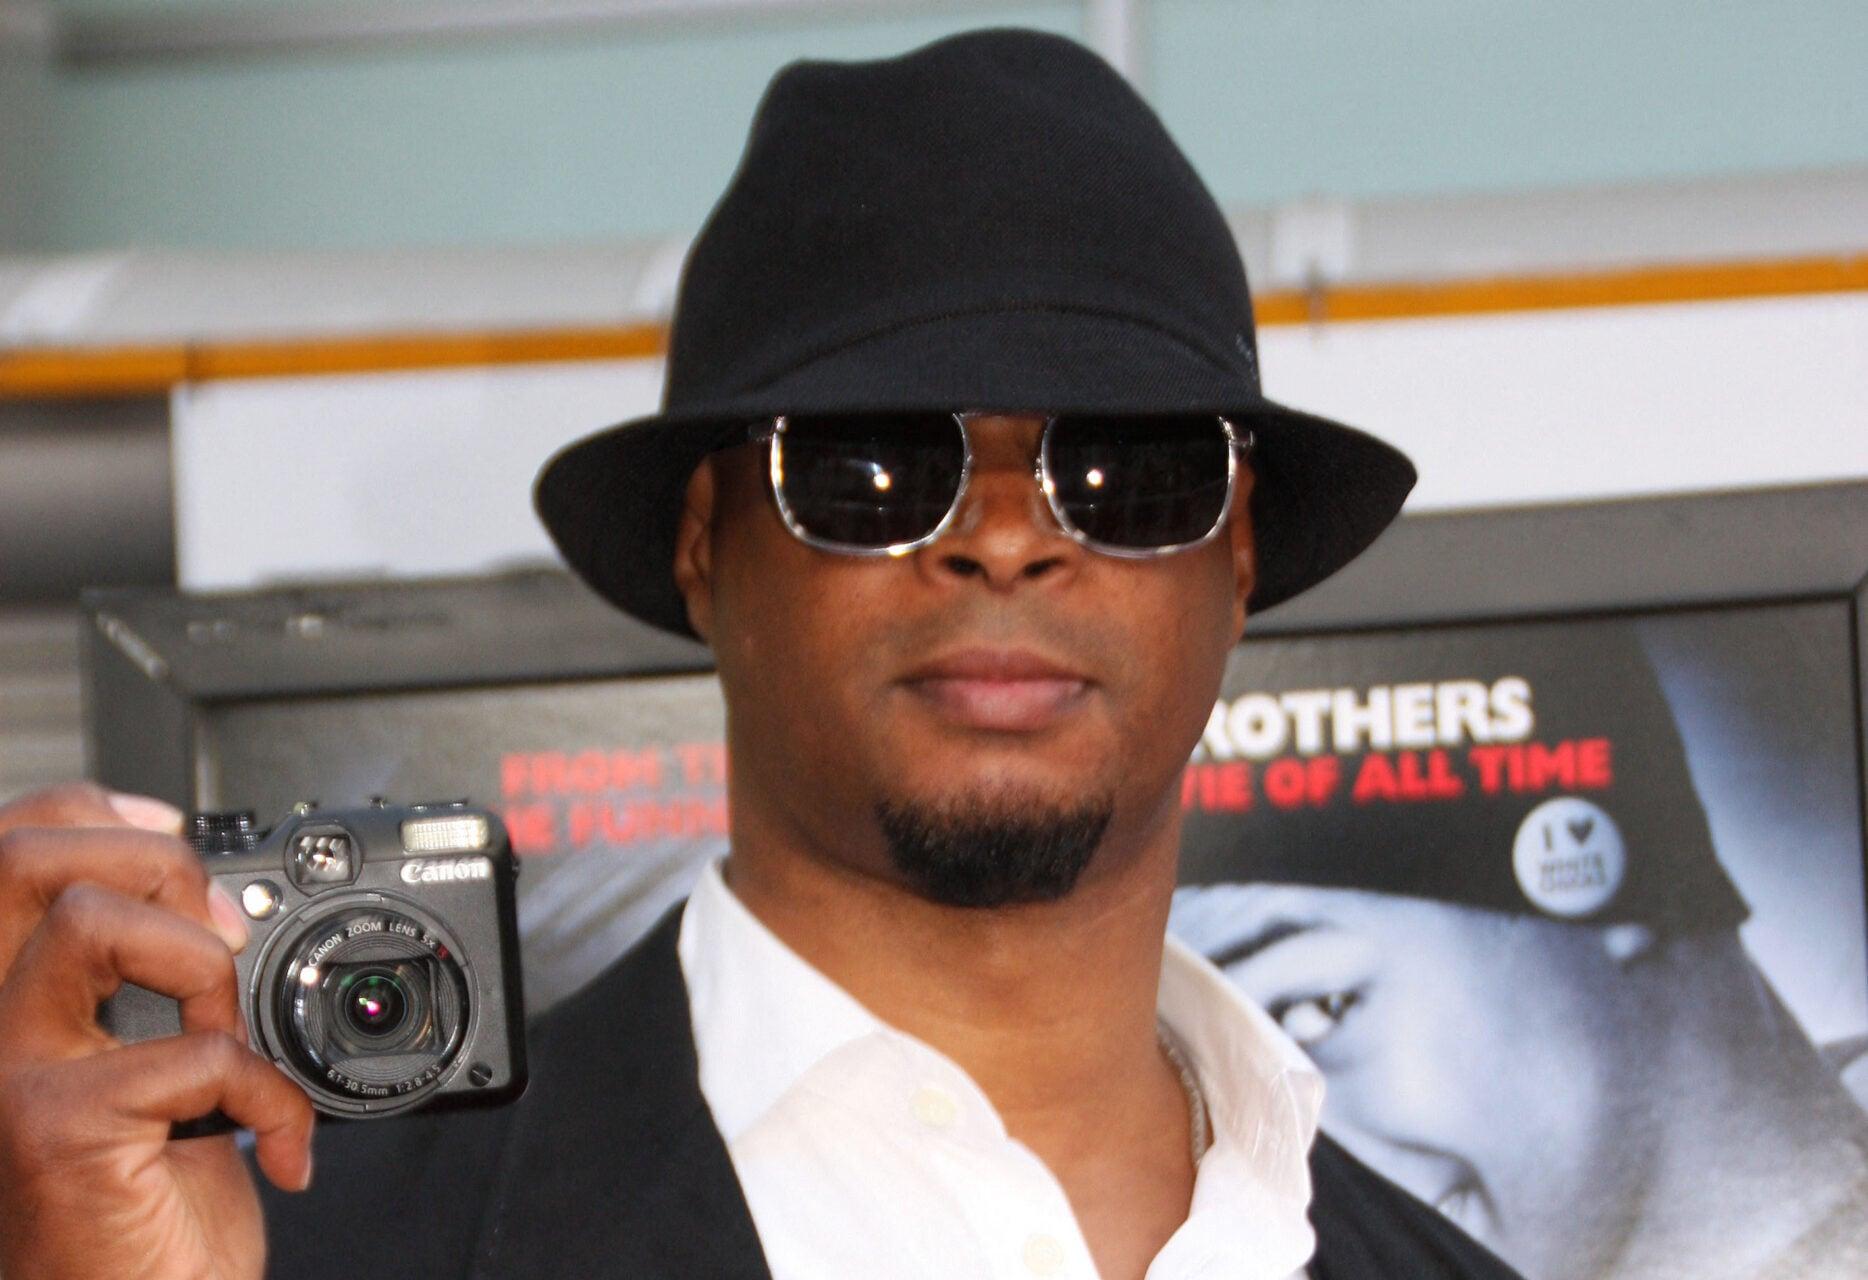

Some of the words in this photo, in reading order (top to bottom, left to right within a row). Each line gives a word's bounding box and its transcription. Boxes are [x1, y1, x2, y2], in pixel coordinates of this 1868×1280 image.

[1264, 755, 1341, 812] OF
[1352, 747, 1463, 804] ALL
[1469, 736, 1613, 796] TIME
[401, 857, 491, 884] Canon
[308, 933, 342, 967] CANON
[345, 921, 382, 938] ZOOM
[388, 922, 417, 938] LENS
